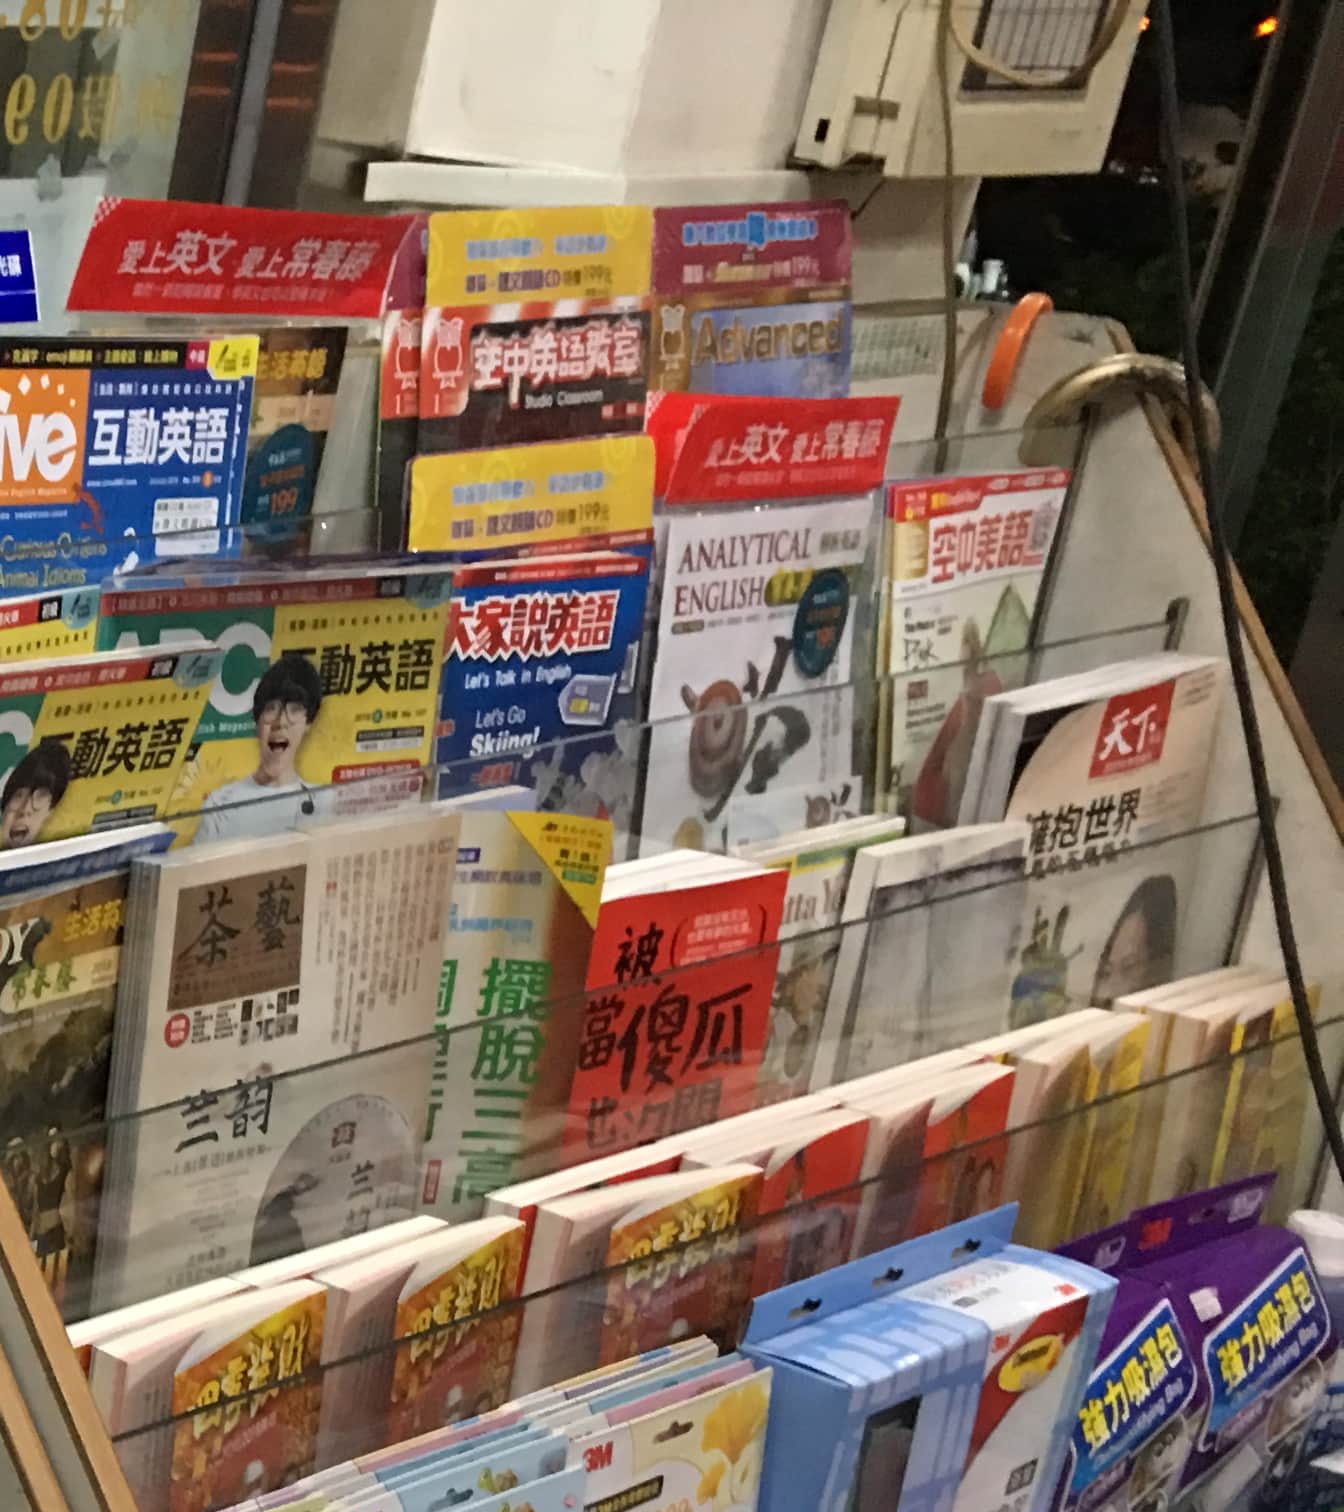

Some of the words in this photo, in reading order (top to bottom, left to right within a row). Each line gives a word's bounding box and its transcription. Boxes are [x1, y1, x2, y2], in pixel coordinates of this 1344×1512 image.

[472, 324, 642, 405] 空中英語教室
[691, 312, 843, 367] Advanced
[87, 405, 230, 469] 互動英語
[677, 526, 812, 575] ANALYTICAL
[931, 509, 1033, 584] 空中美語
[445, 588, 620, 660] 大家說英語
[673, 576, 767, 617] ENGLISH
[469, 726, 542, 759] Skiing!
[582, 1440, 614, 1473] 3M
